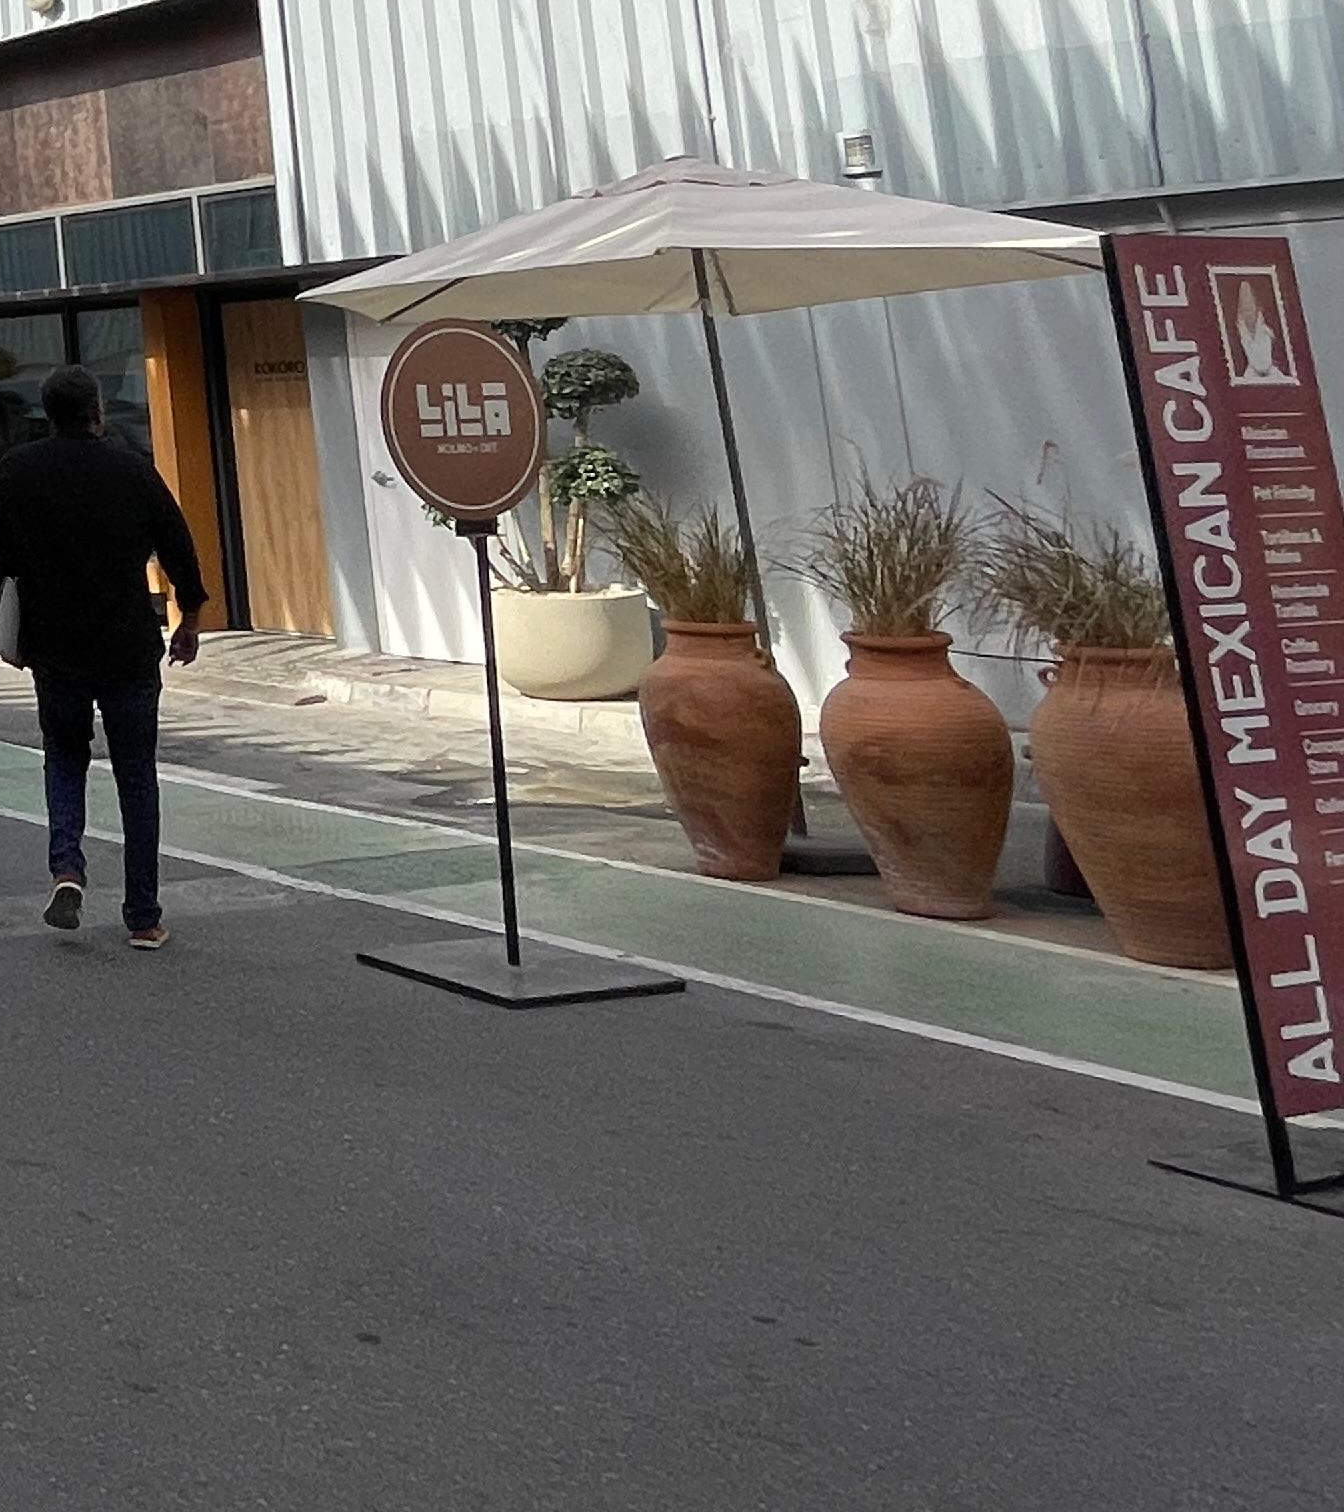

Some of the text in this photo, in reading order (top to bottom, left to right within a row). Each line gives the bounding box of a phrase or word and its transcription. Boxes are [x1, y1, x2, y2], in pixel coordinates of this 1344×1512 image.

[1134, 264, 1213, 442] CAFE
[1172, 462, 1277, 764] MEXICAN
[1234, 787, 1308, 919] DAY
[1270, 934, 1341, 1083] ALL
